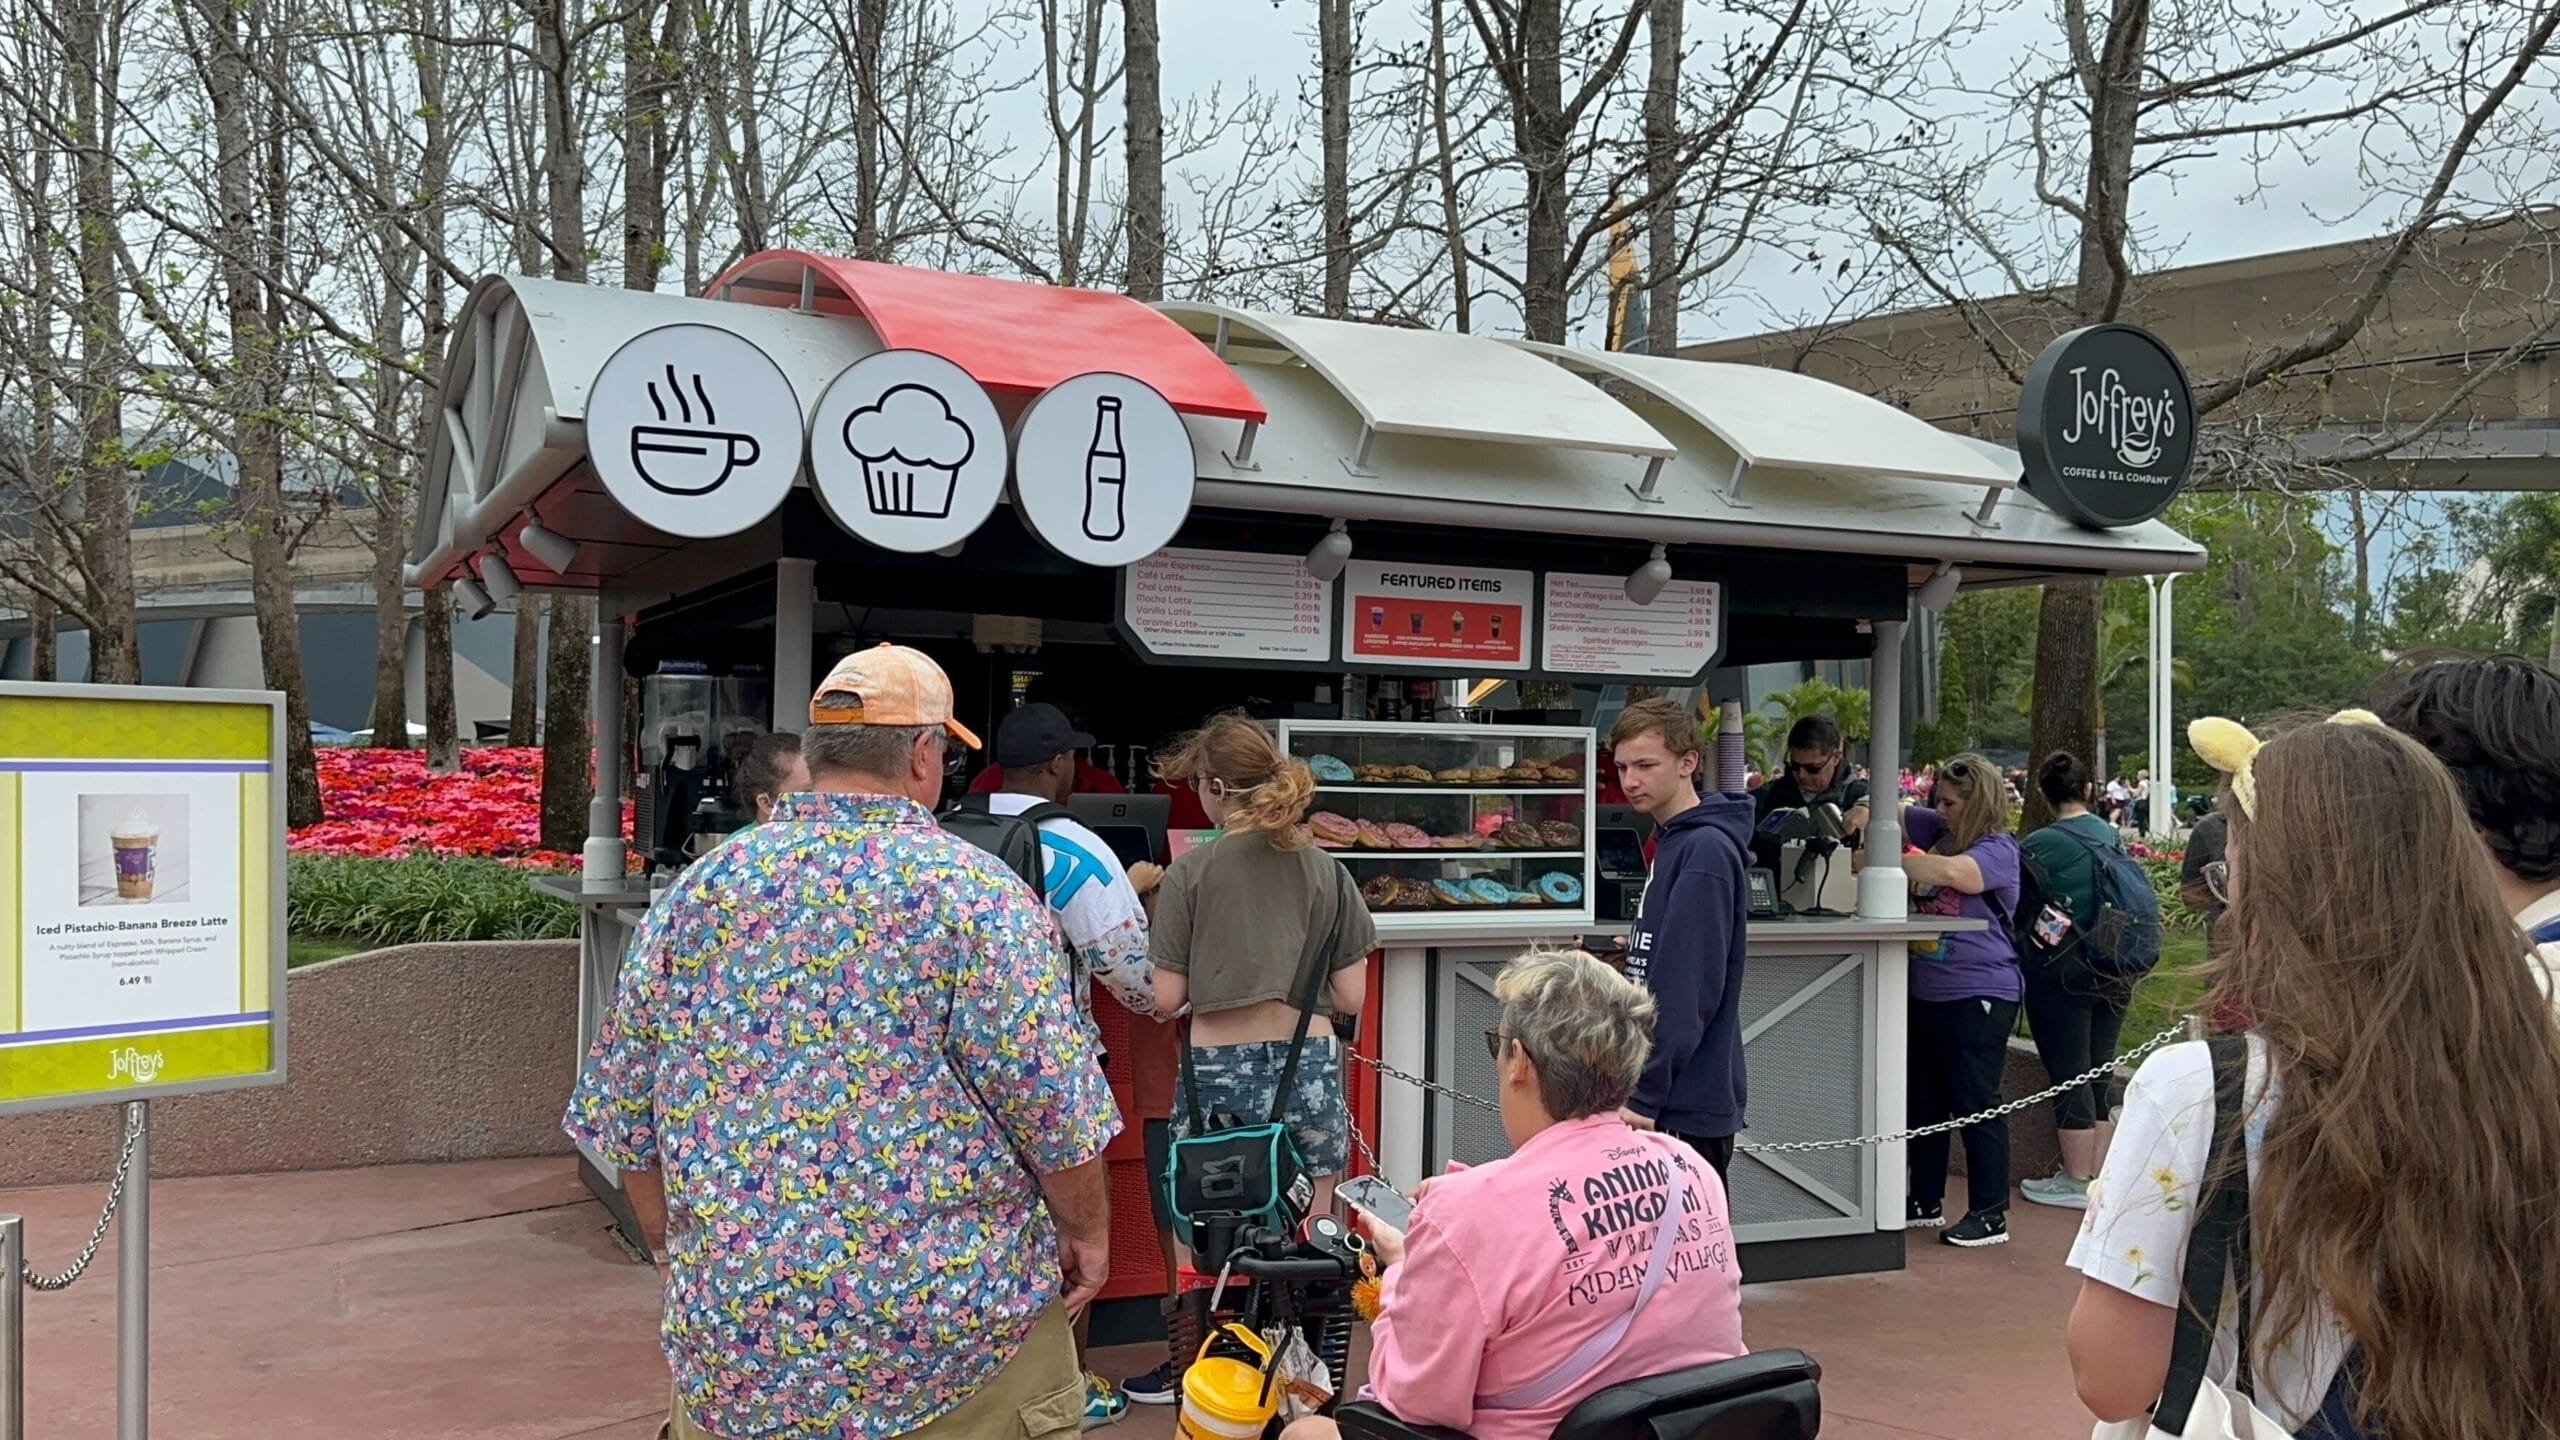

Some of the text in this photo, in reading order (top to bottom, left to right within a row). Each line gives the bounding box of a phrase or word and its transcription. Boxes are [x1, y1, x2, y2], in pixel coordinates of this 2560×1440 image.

[2062, 366, 2175, 451] Joffrey's
[2063, 466, 2169, 486] COFFEE & TEA COMPANY
[1137, 560, 1169, 569] Double
[1170, 560, 1211, 572] Espresso
[1137, 571, 1313, 589] Café Latte 5.39
[1380, 573, 1502, 593] FEATURED ITEMS
[1136, 583, 1313, 600] Chai Latte 5.39
[1136, 594, 1313, 611] Mocha Latte 6.09
[1564, 601, 1600, 610] Chocolate
[1136, 605, 1312, 622] Vanilla Latte 6.09
[1549, 611, 1586, 619] Lemonade
[1136, 617, 1312, 634] Caramel Latte 6.09
[1613, 626, 1629, 634] Cold
[1611, 637, 1648, 648] Beverages
[36, 916, 228, 936] Iced Pistachio-Banana Breeze Latte
[57, 943, 75, 951] nutty
[157, 937, 182, 945] Banana
[59, 952, 91, 961] Pistachio
[92, 951, 112, 961] Syrup
[112, 950, 138, 960] topped
[155, 947, 185, 956] Whipped
[186, 945, 208, 953] Cream
[111, 958, 160, 969] (non-alcoholic)
[119, 976, 141, 986] 6.49
[107, 1047, 164, 1080] Joffrey's
[1601, 1145, 1647, 1161] Disney's
[1584, 1158, 1670, 1206] ANIMA
[1581, 1184, 1701, 1241] KINGDM
[1568, 1241, 1728, 1306] KIDAN VILLAGE
